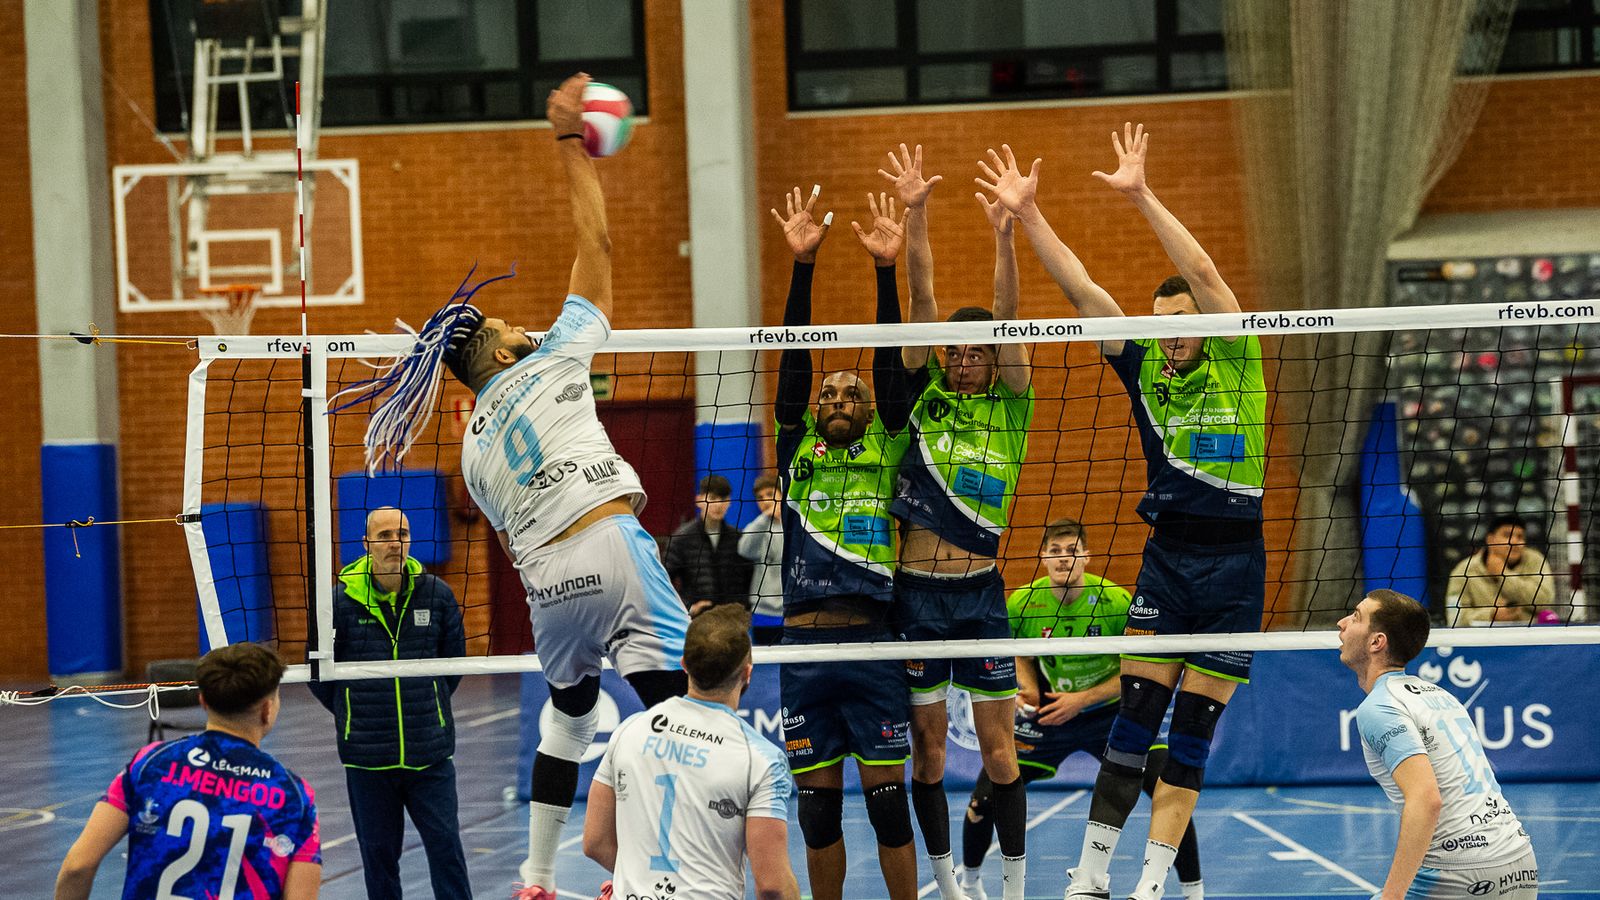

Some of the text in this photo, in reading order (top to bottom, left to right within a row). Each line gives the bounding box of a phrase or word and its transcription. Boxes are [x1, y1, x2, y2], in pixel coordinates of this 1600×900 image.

[1242, 313, 1334, 330] rfevb.com
[1498, 303, 1594, 321] rfevb.com
[749, 328, 838, 343] rfevb.com
[993, 322, 1083, 338] rfevb.com
[504, 413, 544, 487] 9
[537, 573, 602, 600] HYUNDAI
[642, 735, 711, 769] FUNES
[160, 761, 286, 810] J.MENGOD
[649, 772, 680, 873] 1
[155, 799, 253, 900] 21
